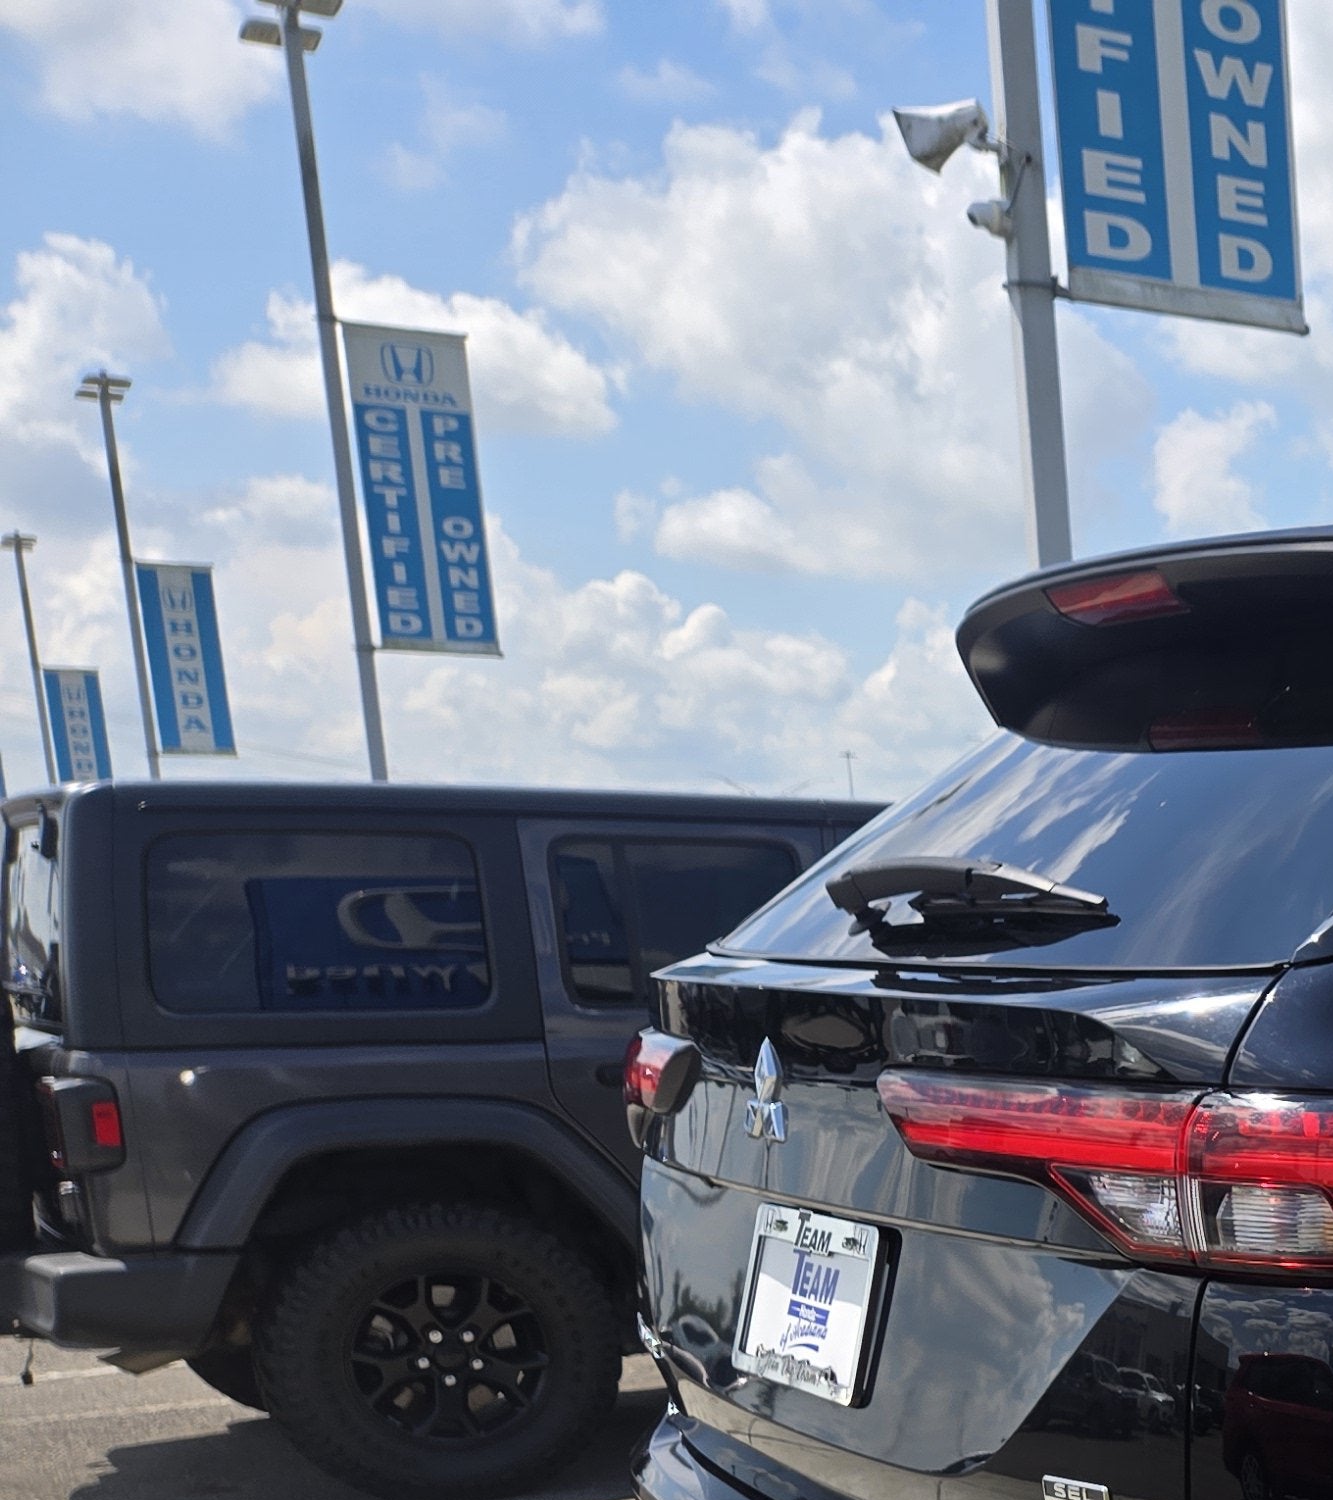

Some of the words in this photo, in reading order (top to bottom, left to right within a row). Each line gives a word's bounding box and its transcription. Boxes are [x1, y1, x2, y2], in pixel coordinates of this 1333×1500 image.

[1194, 0, 1274, 282] OWNED
[363, 383, 457, 405] HONDA
[432, 414, 466, 490] PRE
[363, 408, 423, 634] CERTIFIED
[440, 515, 484, 638] OWNED
[168, 619, 208, 732] HONDA
[792, 1249, 840, 1305] TEAM
[794, 1212, 832, 1253] TEAM
